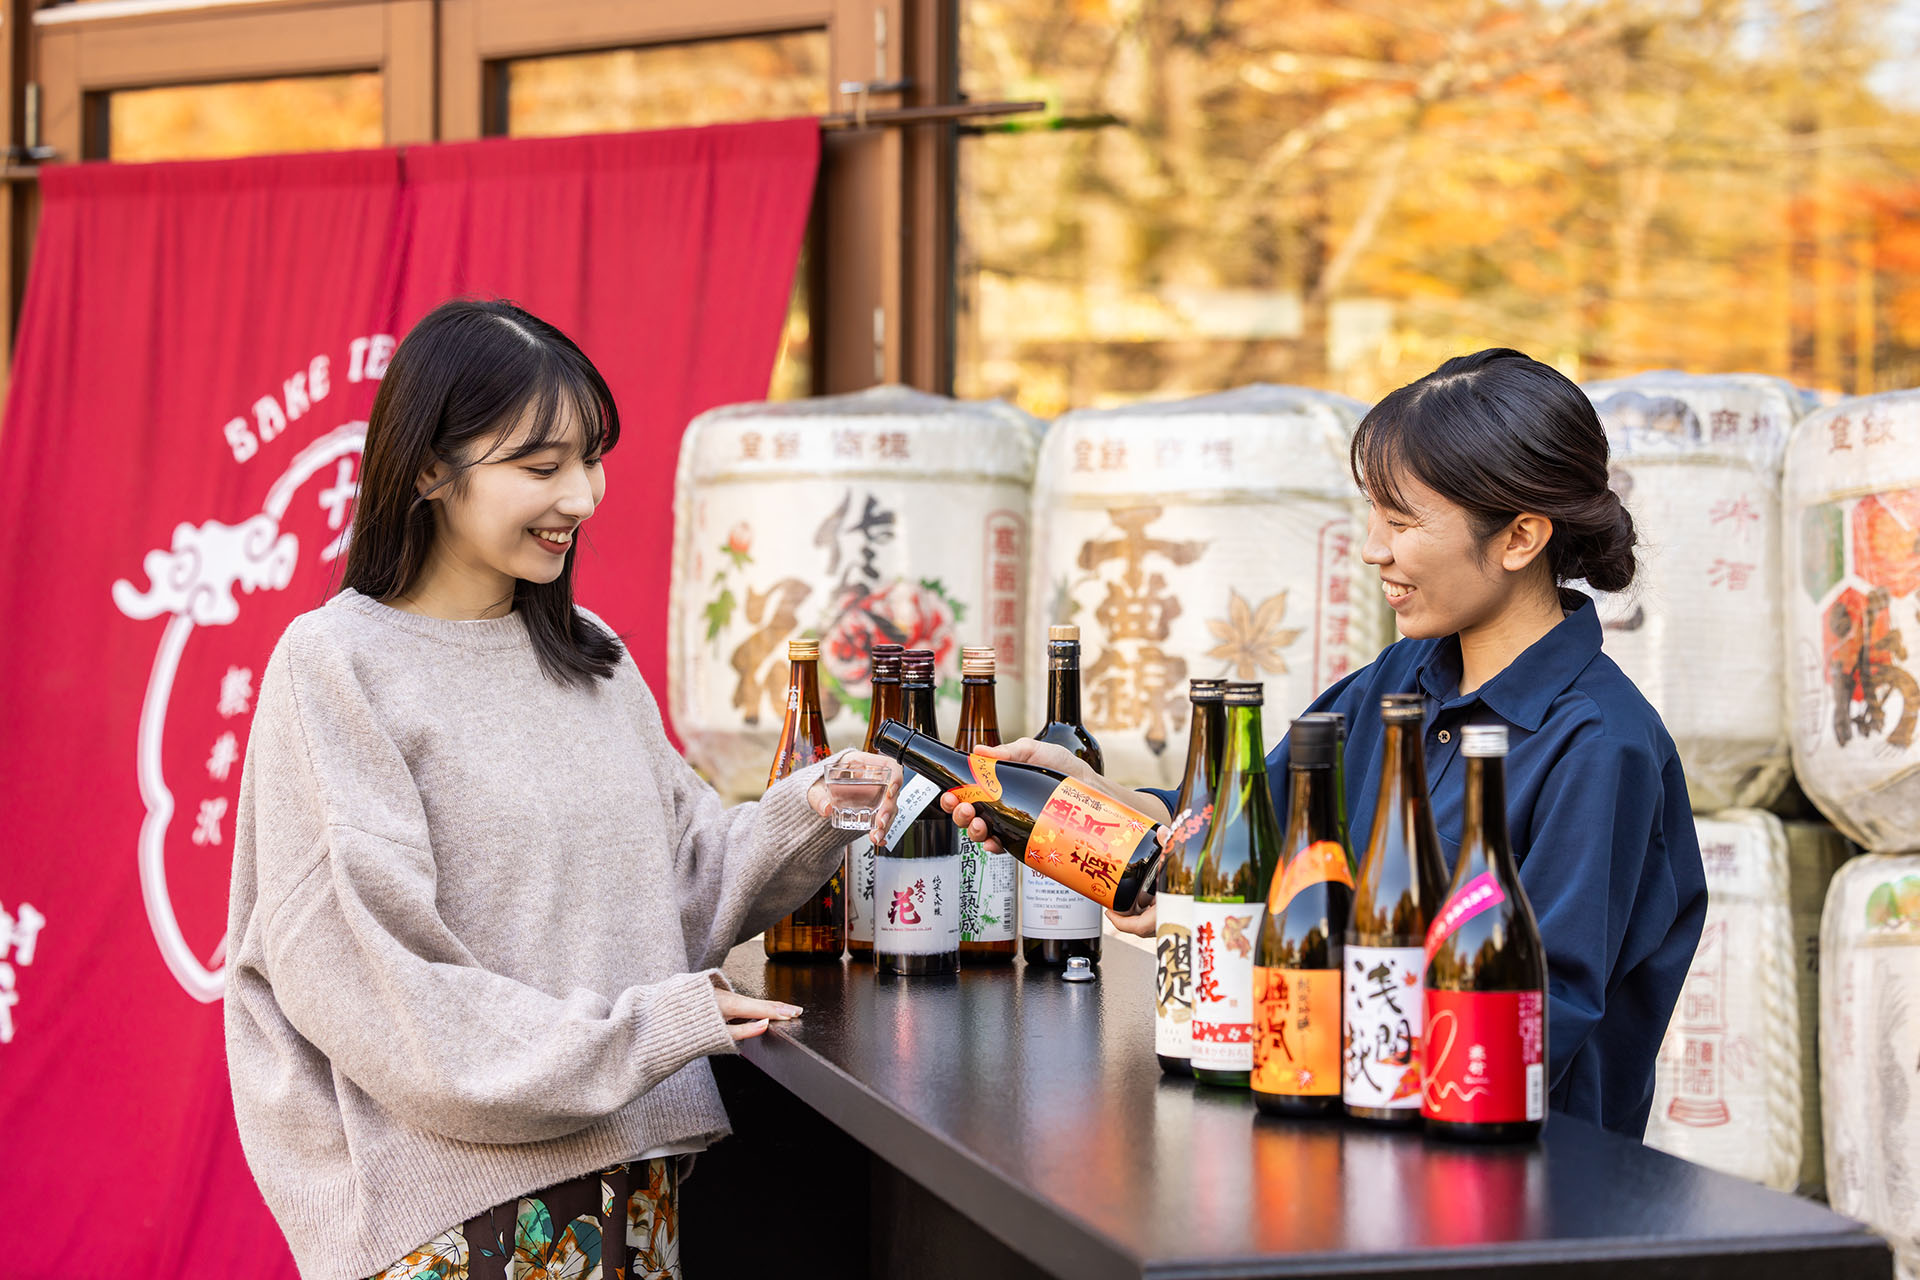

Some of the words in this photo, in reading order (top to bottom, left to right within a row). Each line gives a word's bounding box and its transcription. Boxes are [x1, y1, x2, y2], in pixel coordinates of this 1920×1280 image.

[224, 355, 330, 463] SAKE
[887, 886, 922, 925] 花
[959, 836, 979, 935] 蔵内生熟成
[1195, 921, 1228, 1003] 井筒長
